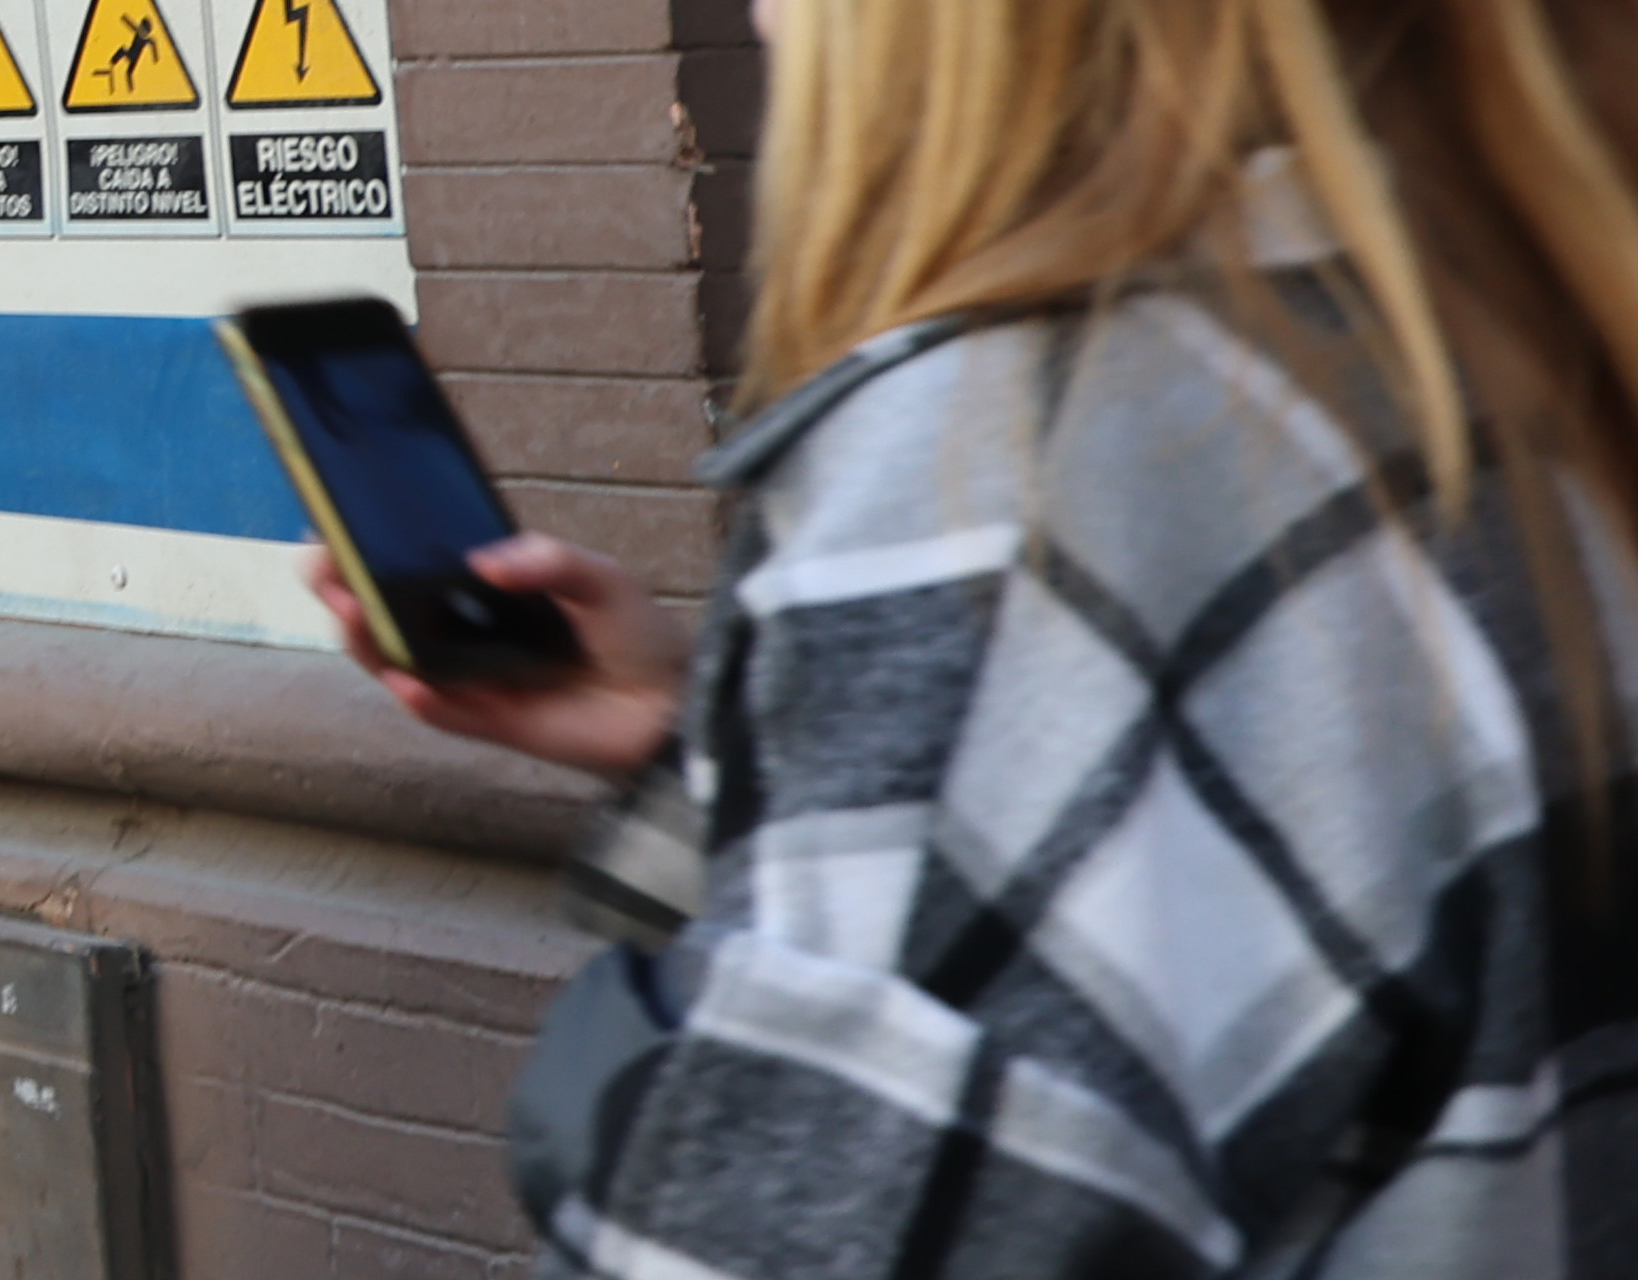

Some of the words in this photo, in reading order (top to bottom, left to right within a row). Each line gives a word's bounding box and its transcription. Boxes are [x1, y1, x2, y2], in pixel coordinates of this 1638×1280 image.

[256, 135, 358, 173] RIESGO
[153, 165, 171, 190] A
[71, 191, 147, 217] DISTINTO
[151, 190, 206, 214] NIVEL
[237, 173, 387, 216] ELÉCTRICO
